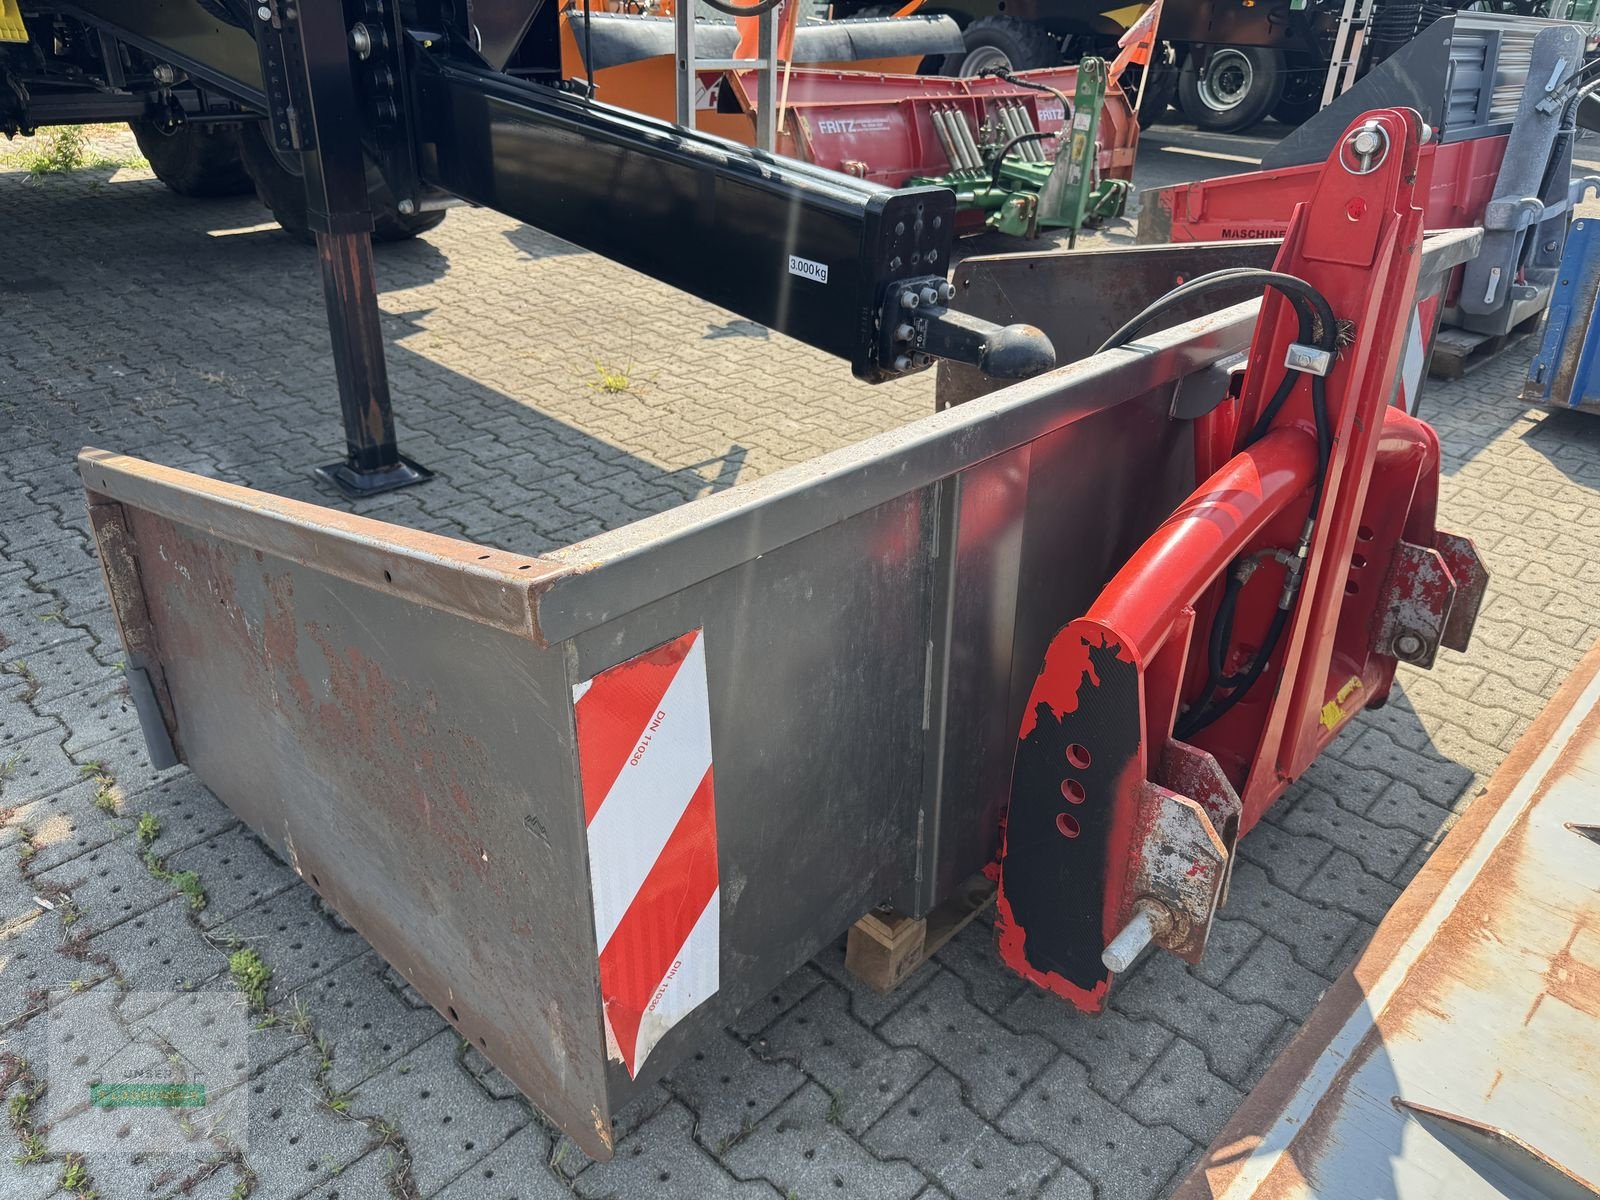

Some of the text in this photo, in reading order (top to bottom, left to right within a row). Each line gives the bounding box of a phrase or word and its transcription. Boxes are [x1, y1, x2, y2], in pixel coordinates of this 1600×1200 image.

[818, 120, 857, 134] FRITZ
[1037, 109, 1065, 120] FRITZ
[630, 710, 666, 766] DIN 11030
[648, 960, 682, 1011] DIN 11030
